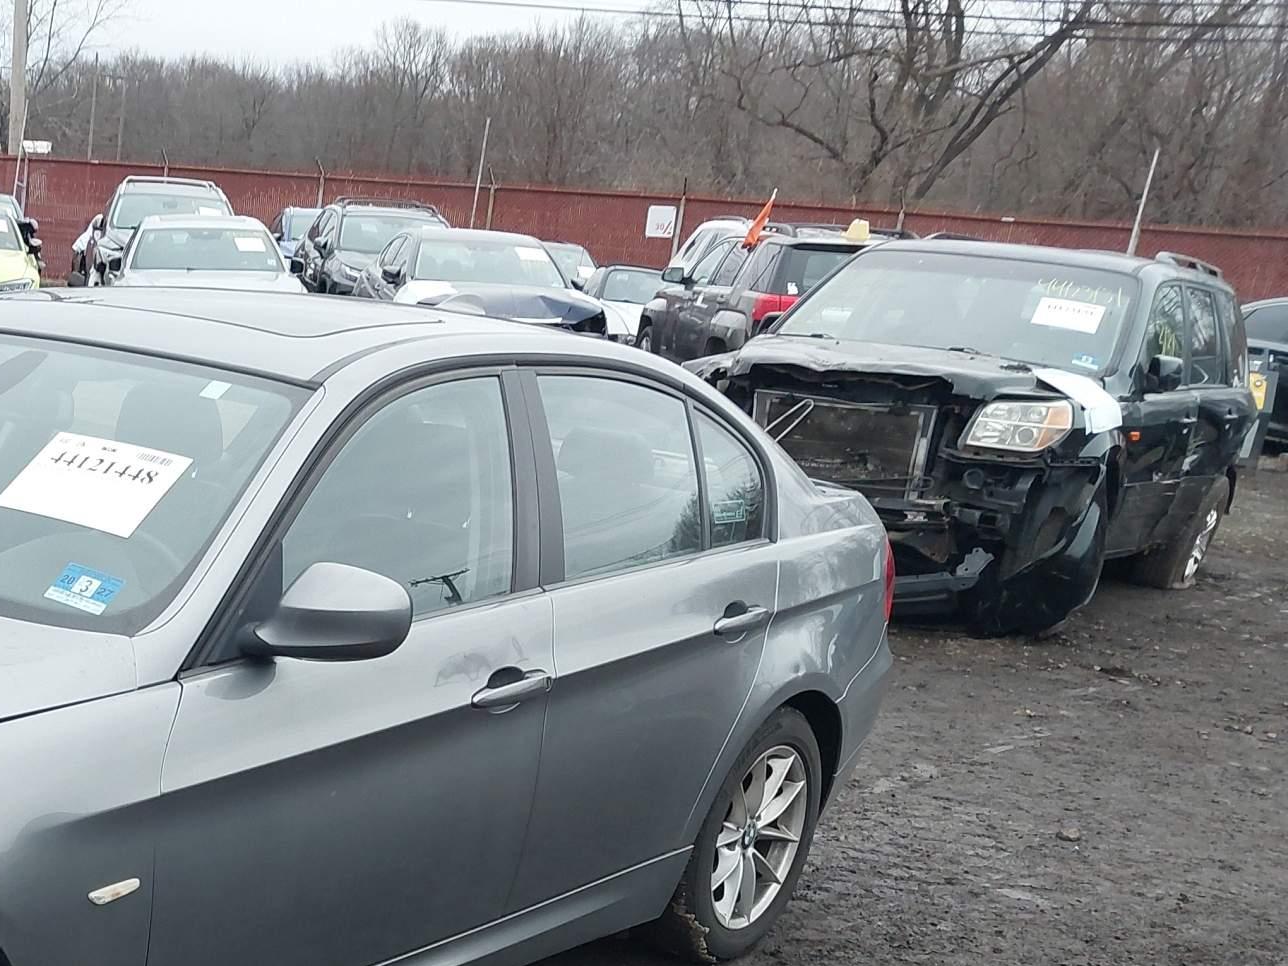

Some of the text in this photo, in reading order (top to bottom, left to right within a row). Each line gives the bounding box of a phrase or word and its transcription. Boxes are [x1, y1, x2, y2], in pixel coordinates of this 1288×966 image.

[50, 451, 159, 484] 44121448
[60, 574, 76, 585] 20
[79, 579, 93, 593] 3
[96, 587, 114, 598] 27
